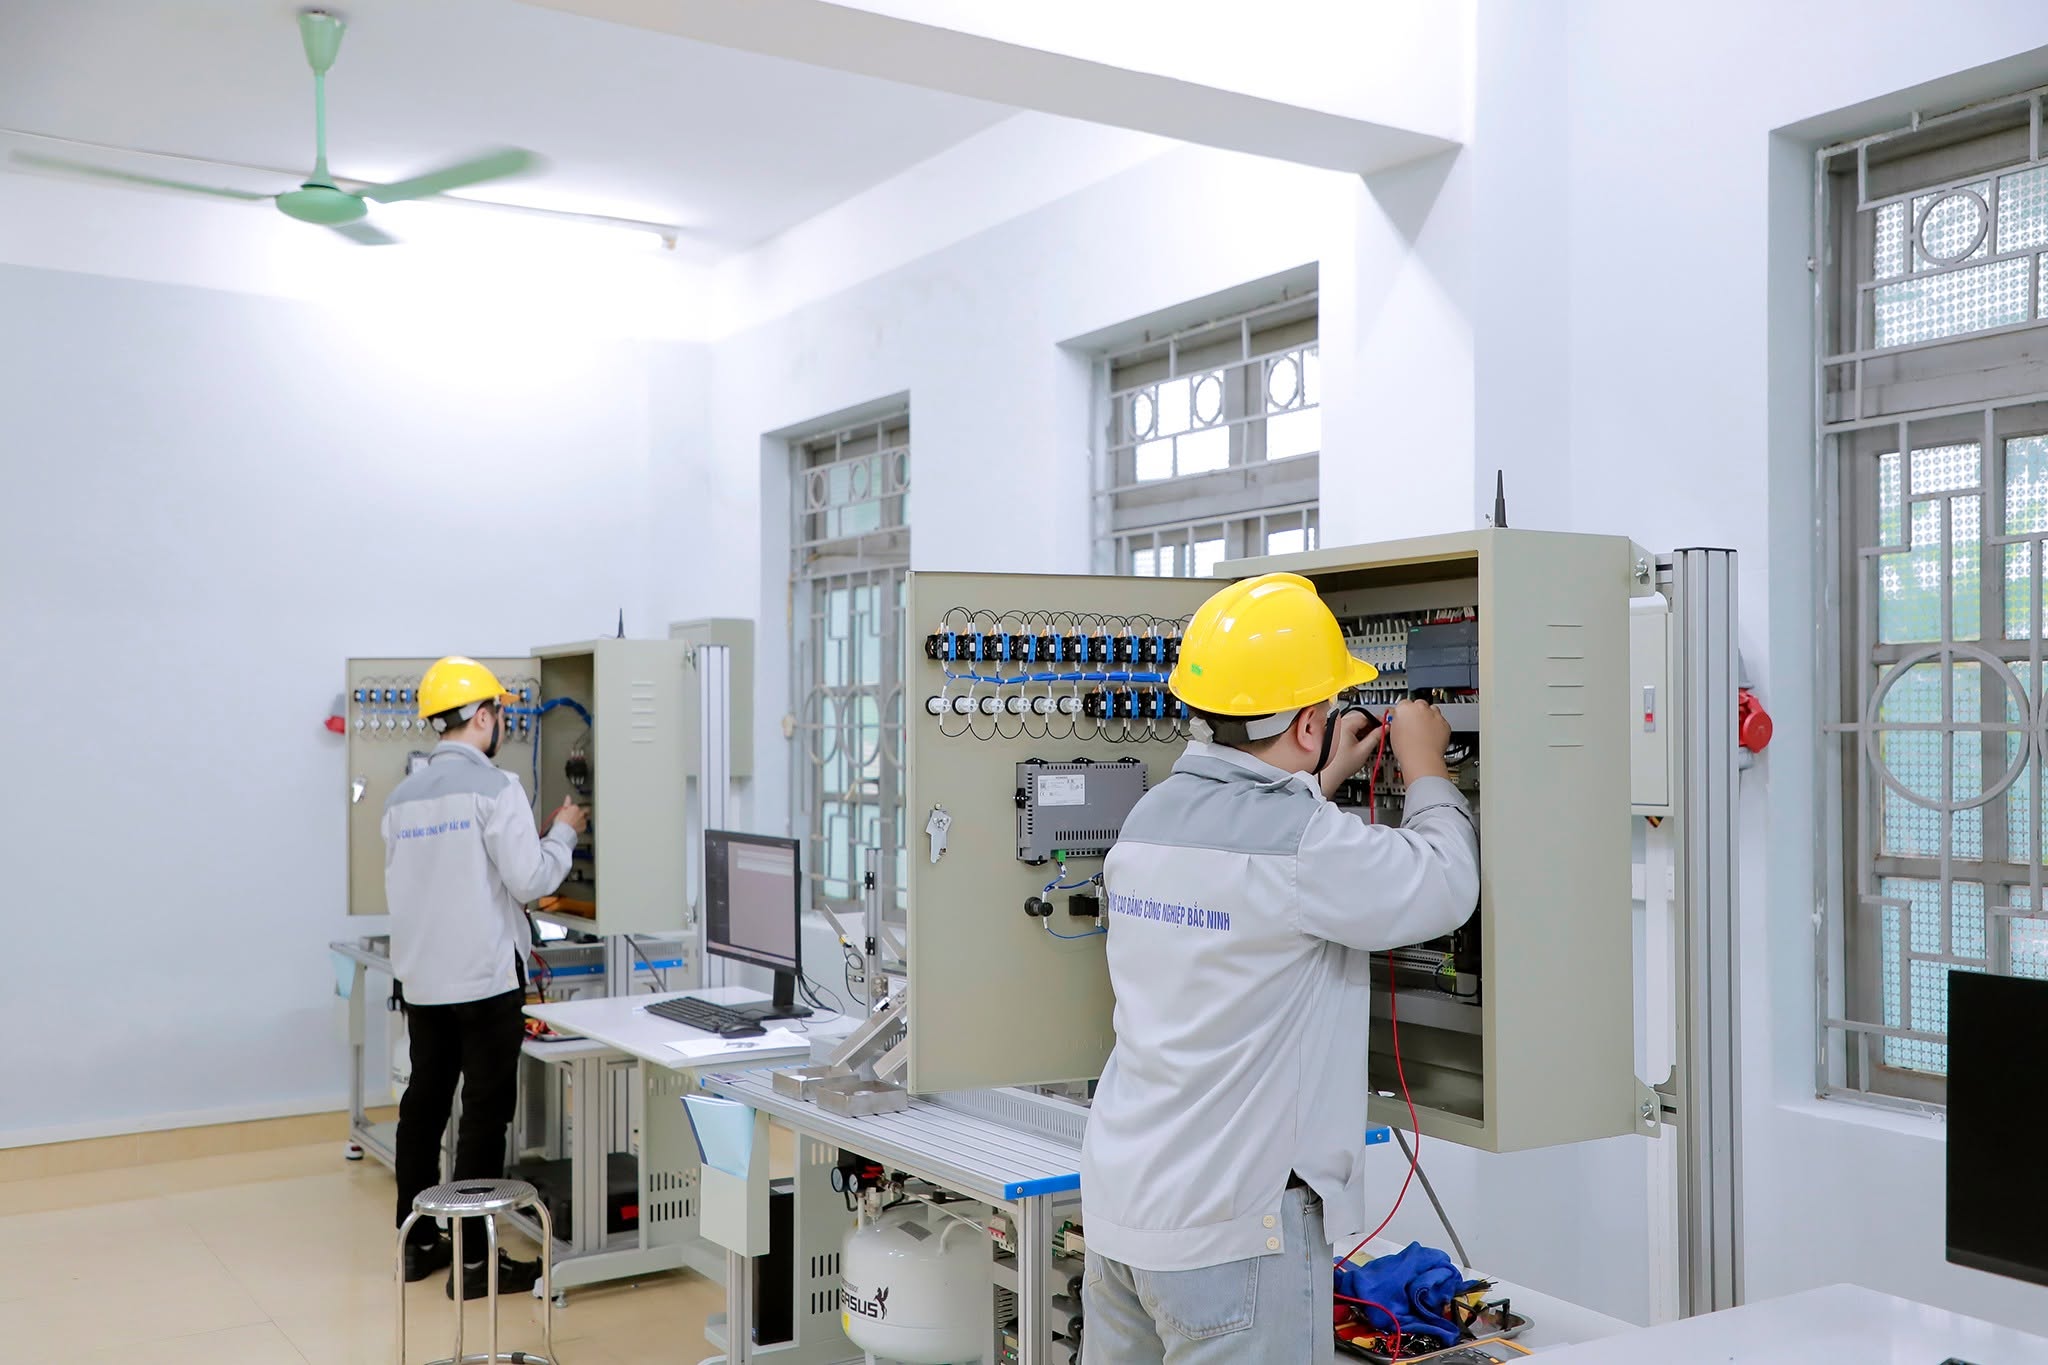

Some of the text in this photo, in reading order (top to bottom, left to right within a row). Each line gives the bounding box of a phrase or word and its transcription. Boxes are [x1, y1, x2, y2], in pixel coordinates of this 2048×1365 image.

[1143, 897, 1162, 920] CÔNG
[1162, 901, 1186, 929] NGHIỆP
[1187, 901, 1205, 928] BẮC
[1207, 910, 1231, 932] NINH
